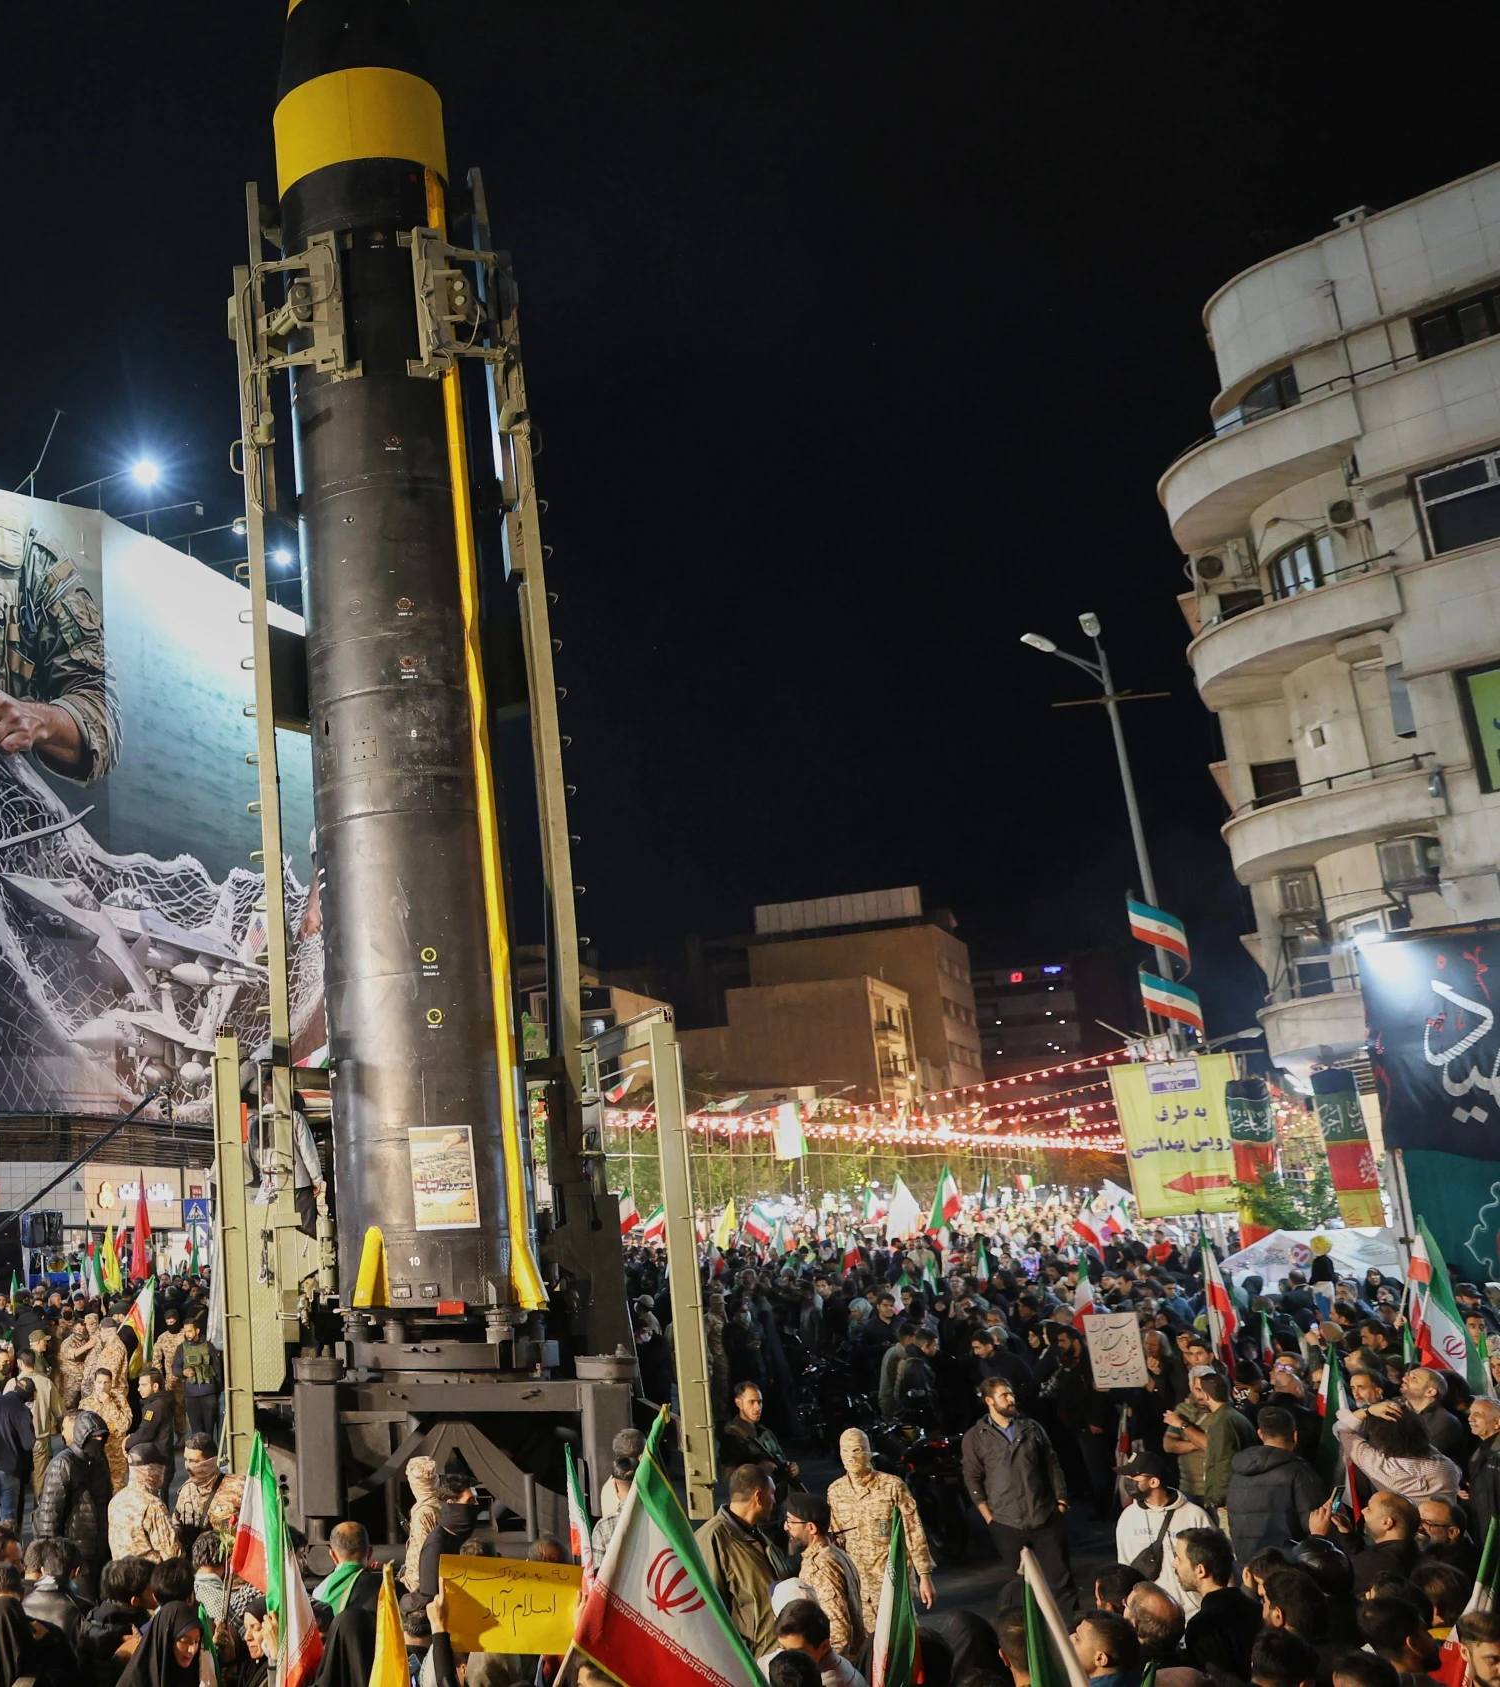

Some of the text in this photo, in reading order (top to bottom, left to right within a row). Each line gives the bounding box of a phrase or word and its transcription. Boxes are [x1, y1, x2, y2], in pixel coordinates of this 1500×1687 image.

[411, 730, 417, 738] 6
[1163, 1080, 1184, 1090] WC
[1155, 1104, 1208, 1126] به طرف
[1131, 1136, 1232, 1160] رویس بهداشتی
[408, 1256, 421, 1267] 10
[482, 1587, 556, 1637] اسلام آباد
